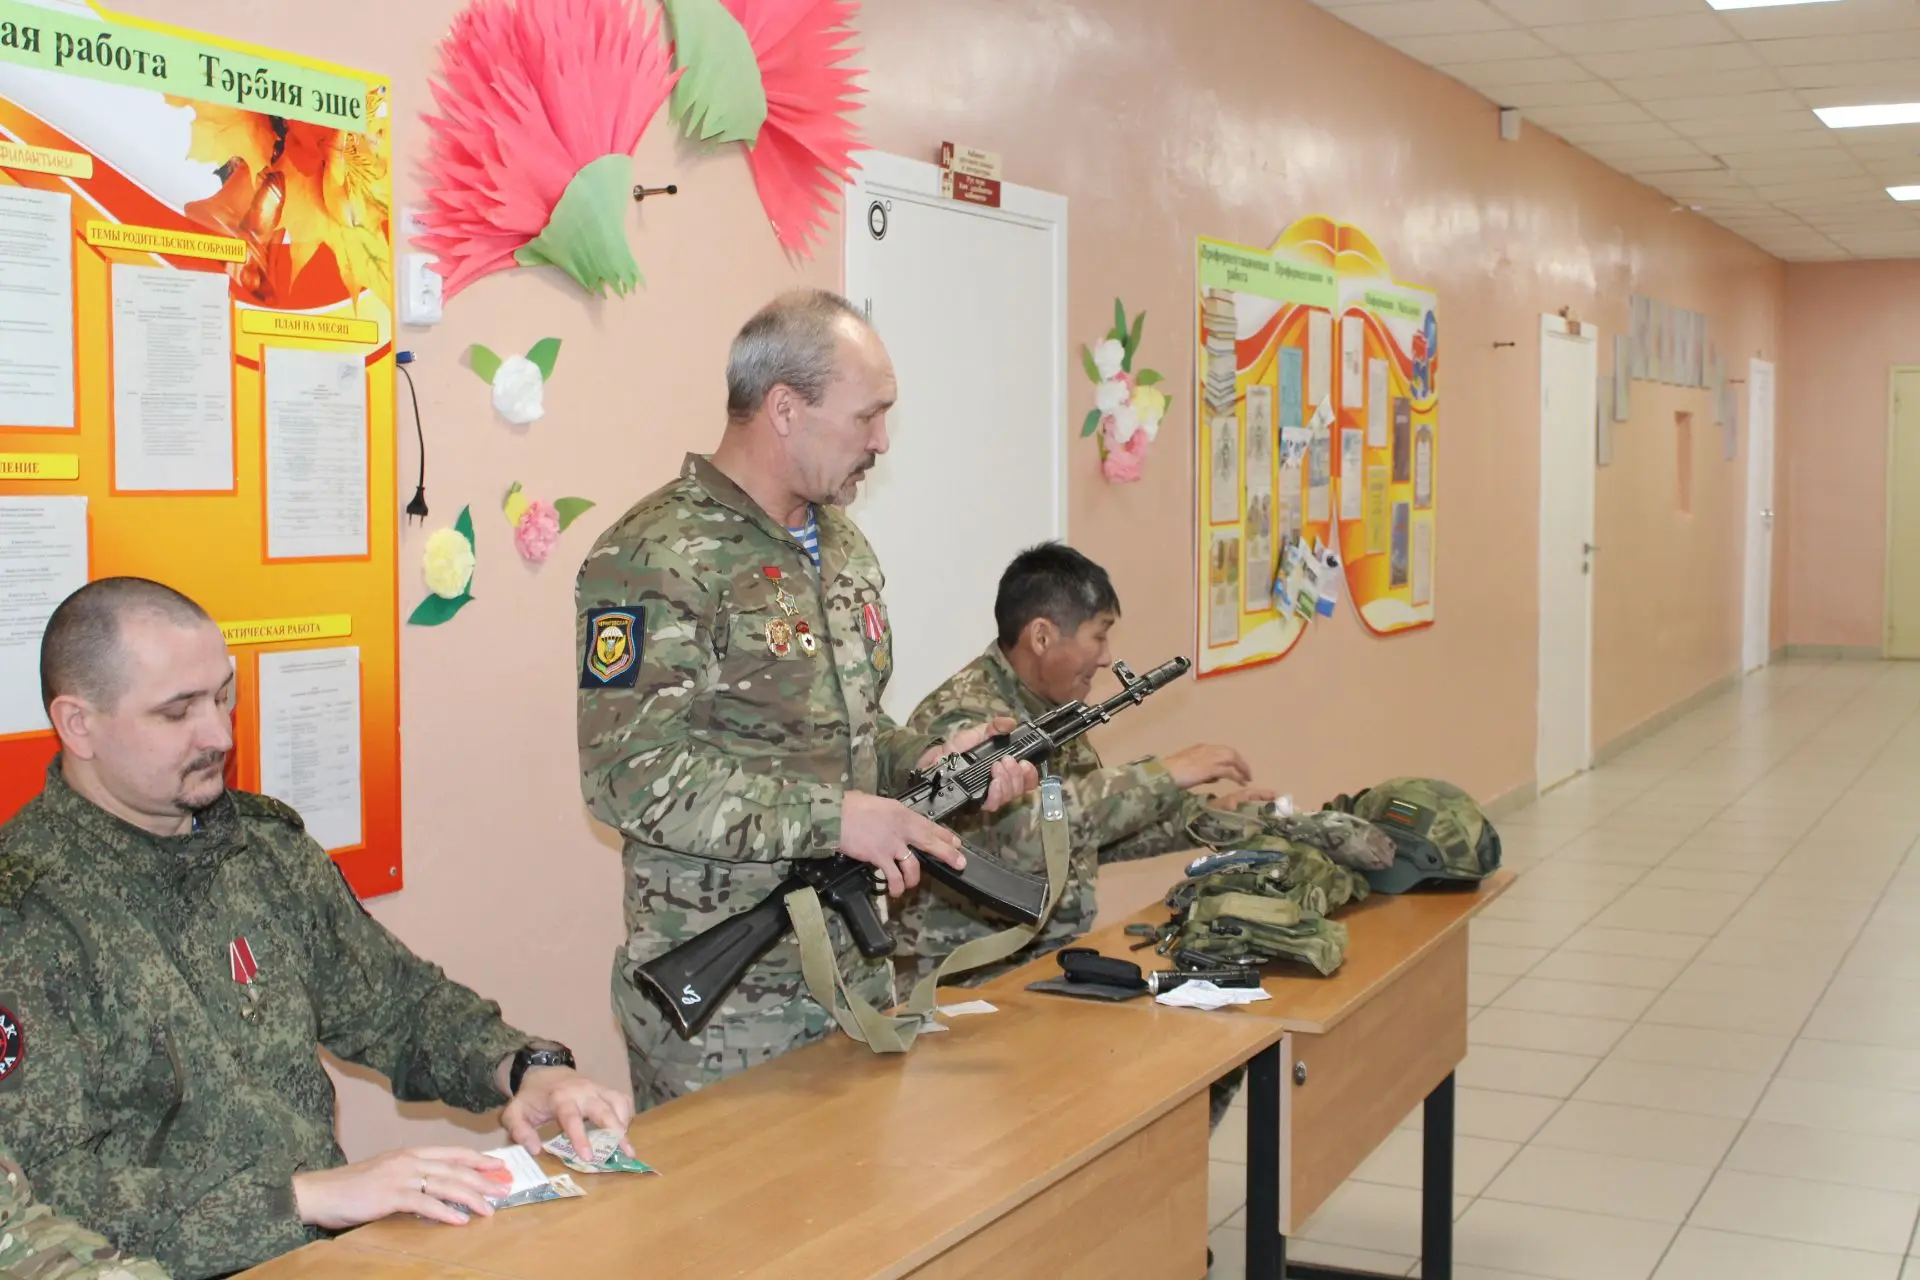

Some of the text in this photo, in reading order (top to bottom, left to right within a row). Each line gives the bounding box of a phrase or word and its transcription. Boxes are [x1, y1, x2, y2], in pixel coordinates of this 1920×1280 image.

[1, 21, 361, 119] ая работа Тәрбия эше
[91, 227, 244, 257] ТЕМЫ РОДИТЕЛЬСКИХ СОБРАНИЙ
[274, 318, 349, 335] ПЛАН НА МЕСЯЦ
[0, 462, 40, 474] ЛЕНИЕ
[287, 622, 321, 635] РАБОТА
